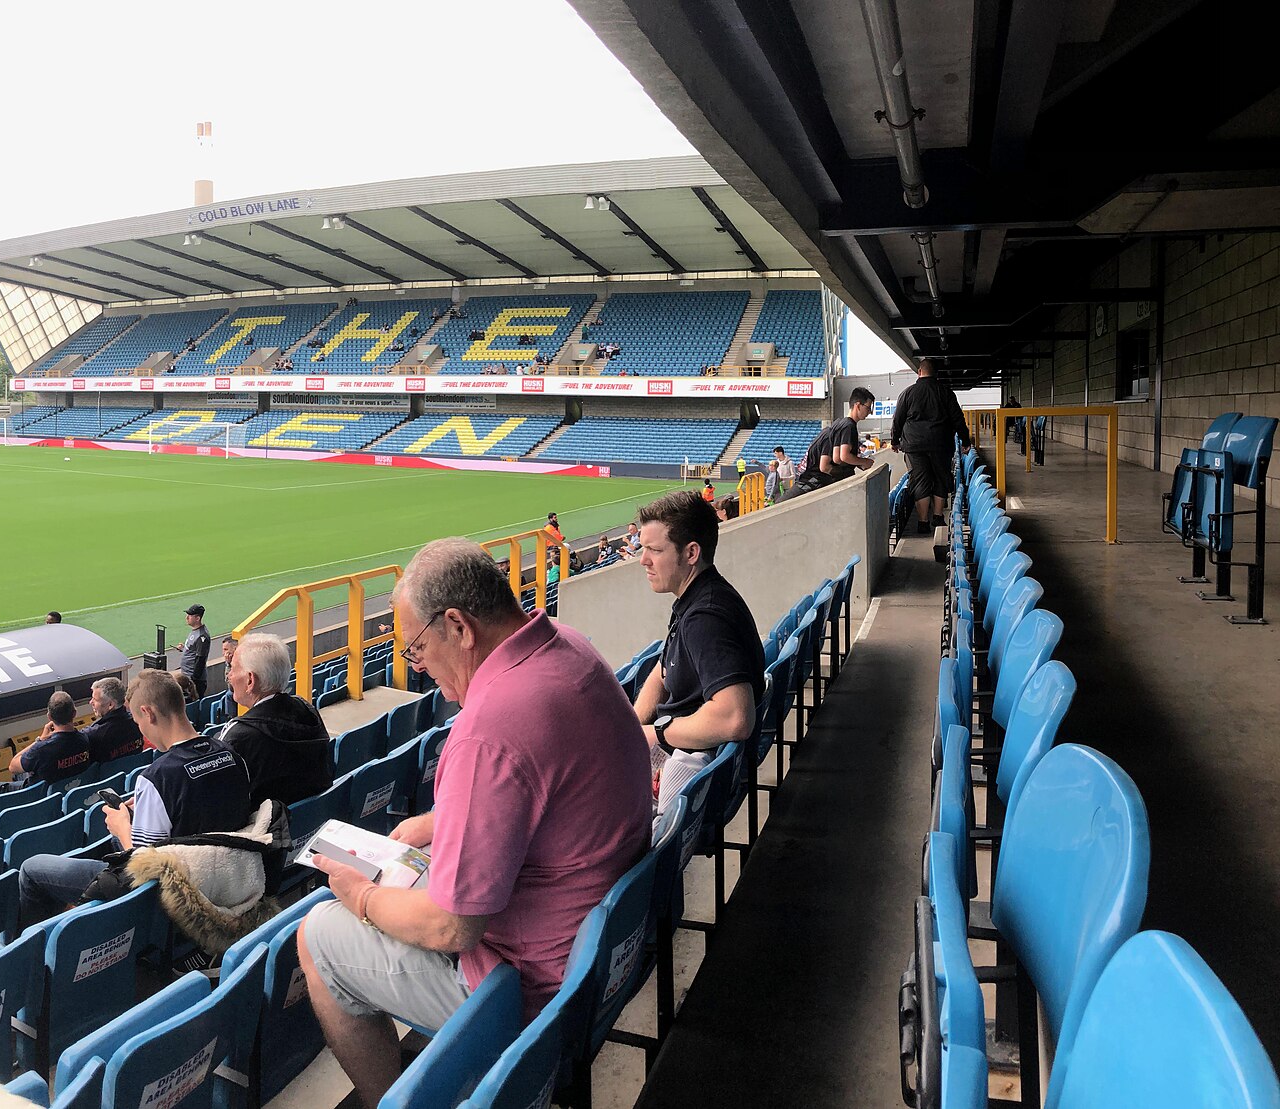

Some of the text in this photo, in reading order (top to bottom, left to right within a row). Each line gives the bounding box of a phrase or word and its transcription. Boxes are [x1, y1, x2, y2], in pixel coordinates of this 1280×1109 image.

[198, 198, 300, 223] COLD BLOW LANE
[523, 379, 544, 387] HUSKI
[595, 382, 633, 390] ADVENTURE!
[272, 392, 340, 405] southlondonpress
[374, 455, 393, 463] HUSKI
[82, 937, 131, 964] AREA BEHIND
[91, 933, 126, 954] DISABLED
[90, 952, 118, 968] PLEASE
[75, 971, 87, 980] DO
[88, 963, 105, 975] NOT
[157, 1049, 204, 1089] DISABLED
[145, 1083, 172, 1105] AREA
